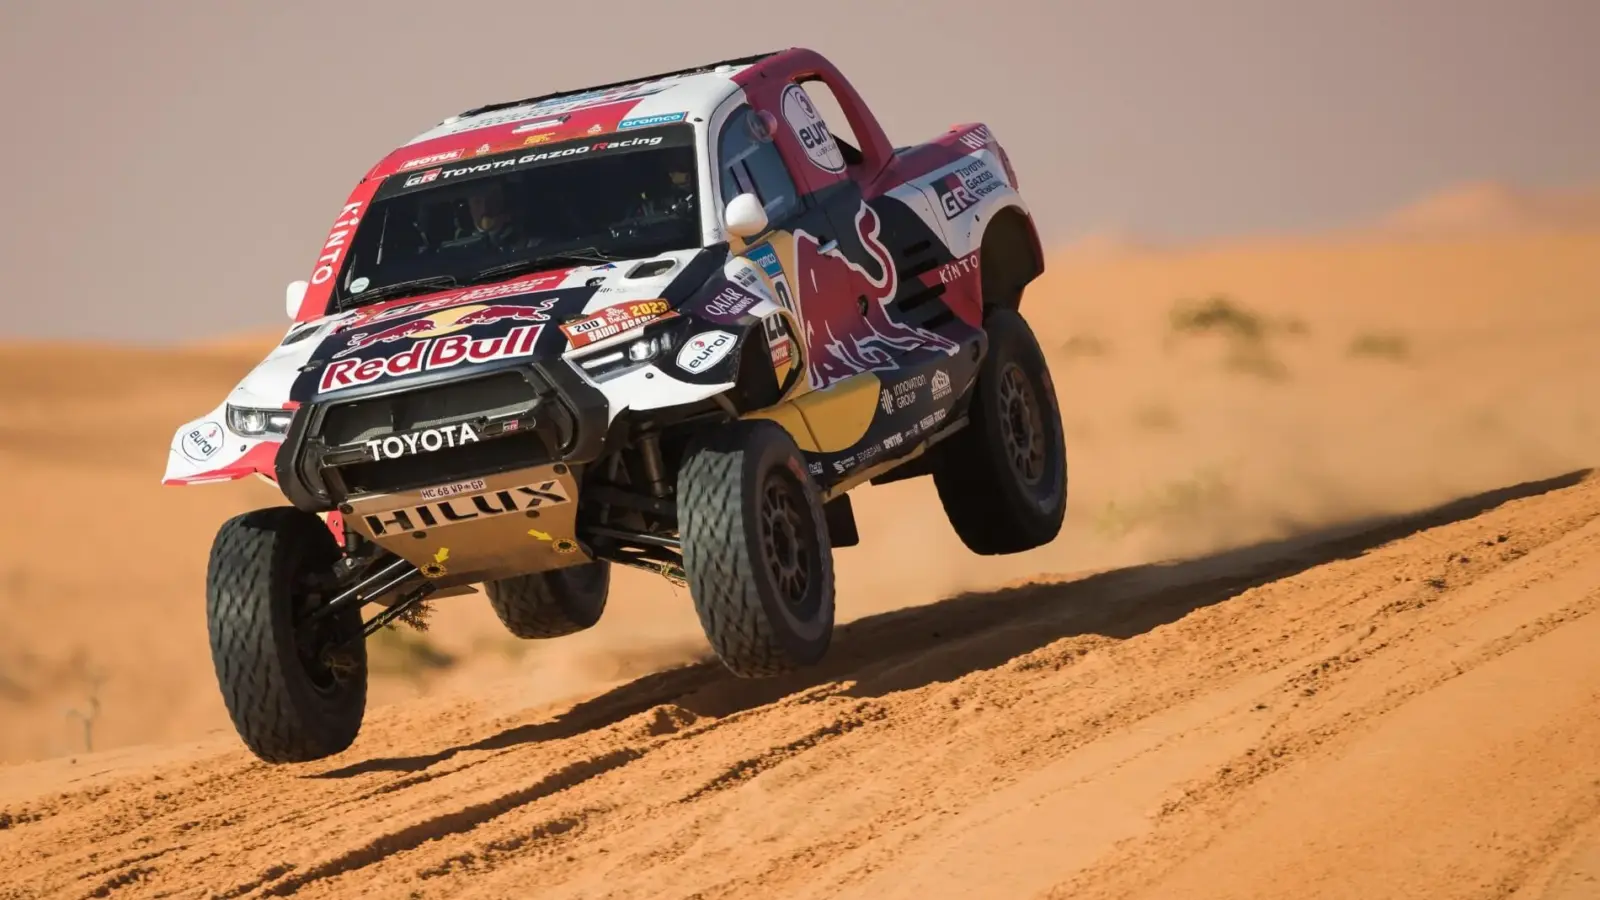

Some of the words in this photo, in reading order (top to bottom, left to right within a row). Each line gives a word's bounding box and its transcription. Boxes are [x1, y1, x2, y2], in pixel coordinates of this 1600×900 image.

[621, 113, 681, 127] aramco
[403, 151, 458, 168] MOTUL
[405, 172, 440, 188] GR
[442, 159, 517, 179] TOYOTA
[518, 145, 590, 165] GAZOO
[591, 136, 664, 152] Racing
[955, 159, 986, 178] TOYOTA
[941, 186, 975, 221] GR
[629, 300, 668, 318] 2023
[705, 287, 743, 316] QATAR
[574, 320, 600, 333] 200
[587, 324, 620, 342] SAUDI
[320, 339, 428, 391] Red
[428, 325, 544, 368] Bull
[689, 334, 730, 369] eurol
[897, 391, 916, 408] GROUP
[189, 429, 217, 456] eurol
[366, 422, 480, 461] TOYOTA
[421, 489, 436, 499] HC
[437, 486, 451, 497] 68
[365, 481, 567, 535] HILUX
